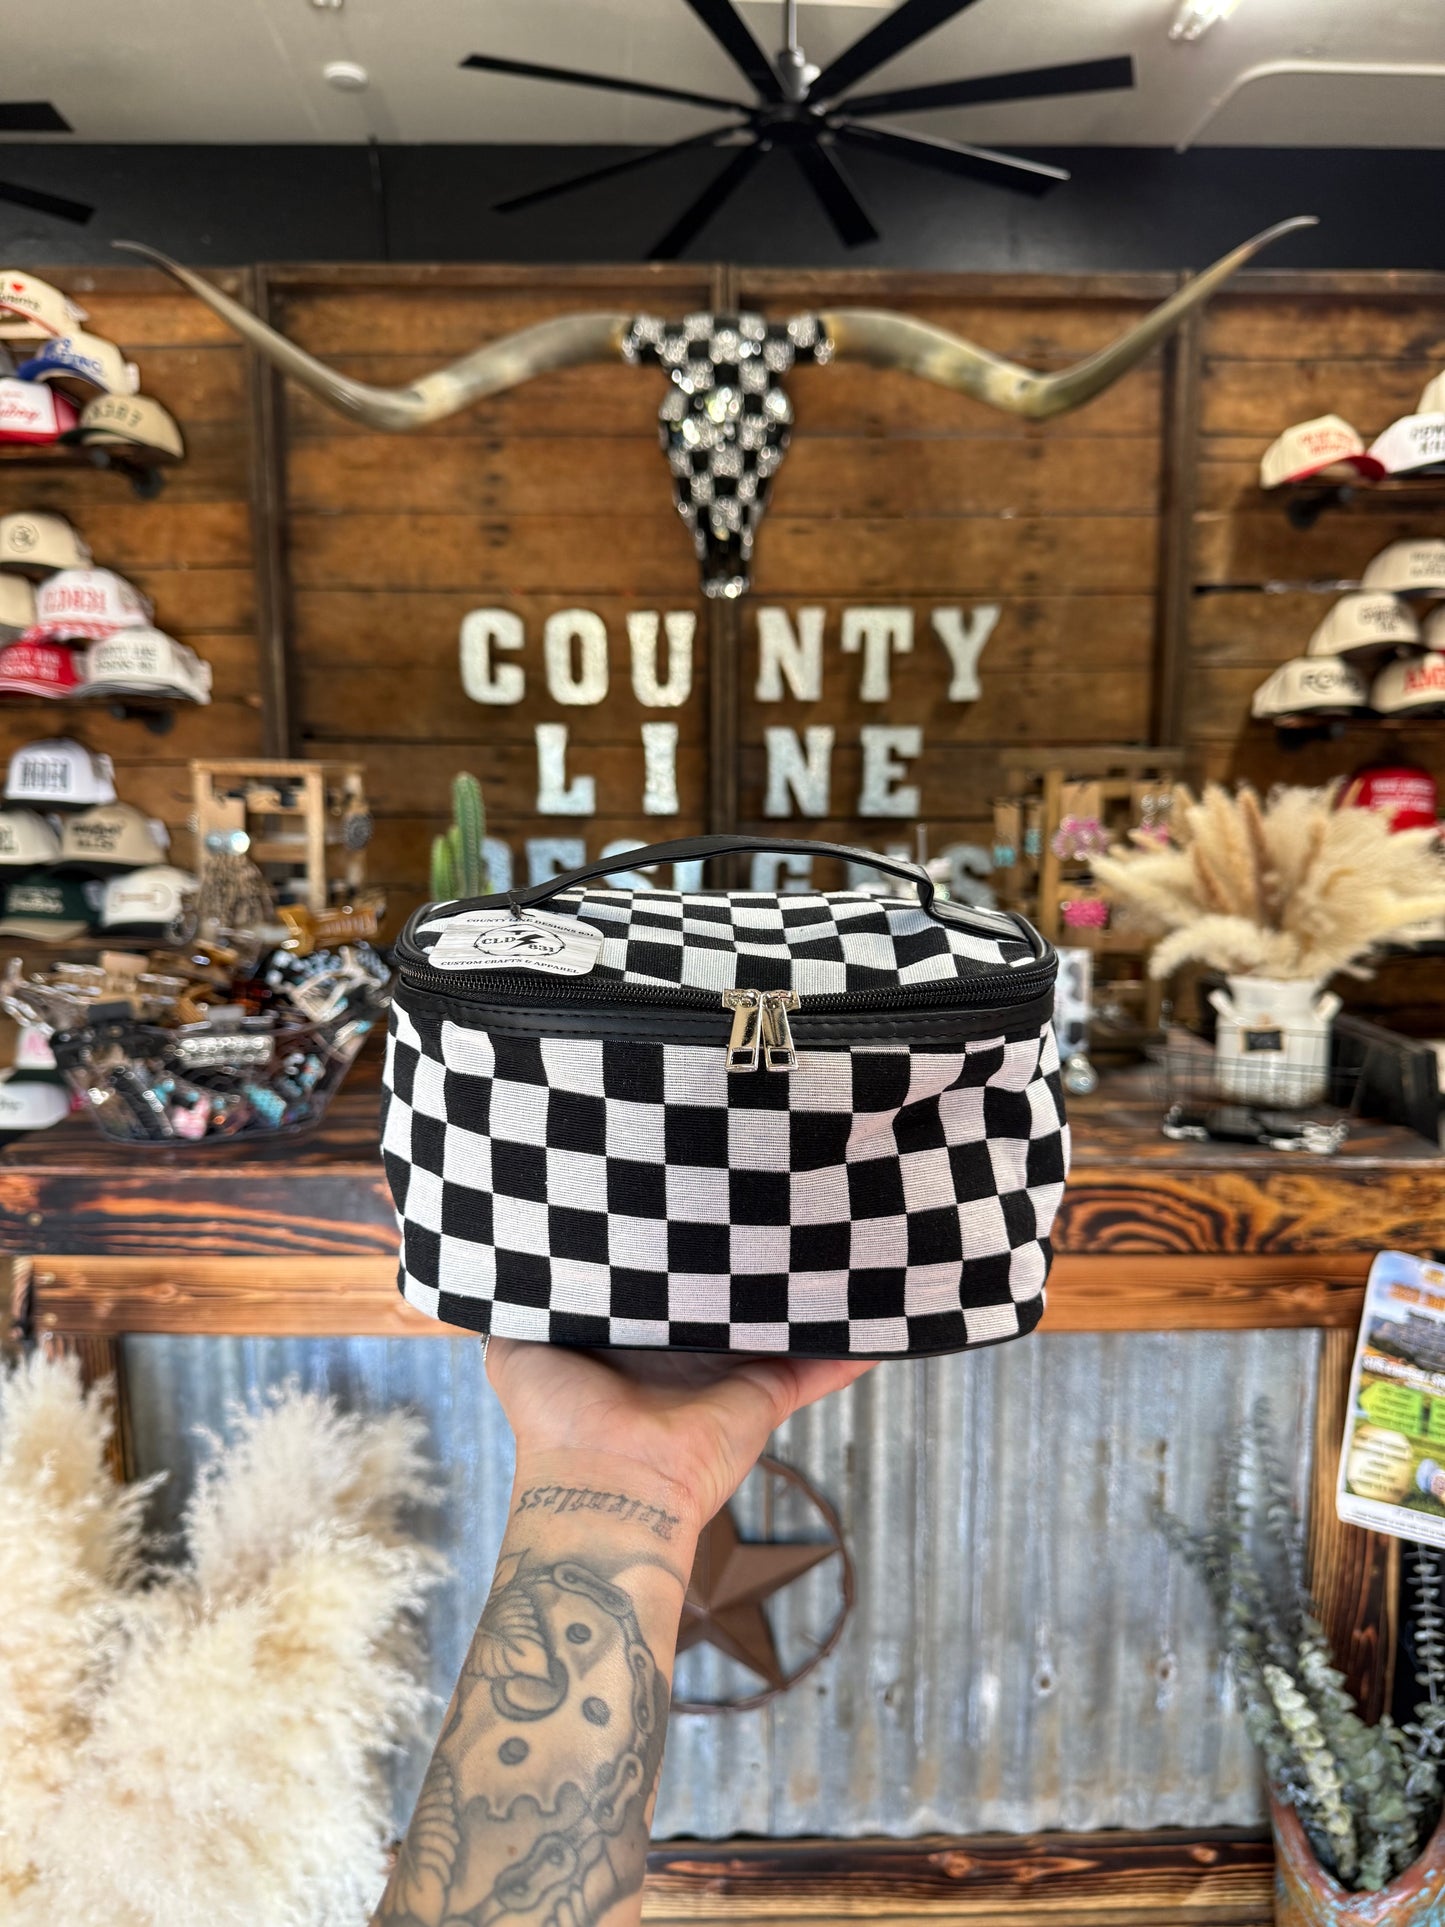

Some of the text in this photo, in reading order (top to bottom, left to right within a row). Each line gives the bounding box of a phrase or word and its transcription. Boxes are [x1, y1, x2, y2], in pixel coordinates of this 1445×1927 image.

[459, 606, 999, 707] COUNTY
[534, 722, 923, 817] LINE
[534, 919, 577, 934] DESIGNS
[481, 936, 517, 946] CLD
[528, 943, 555, 953] 831
[534, 960, 580, 974] APPAREL
